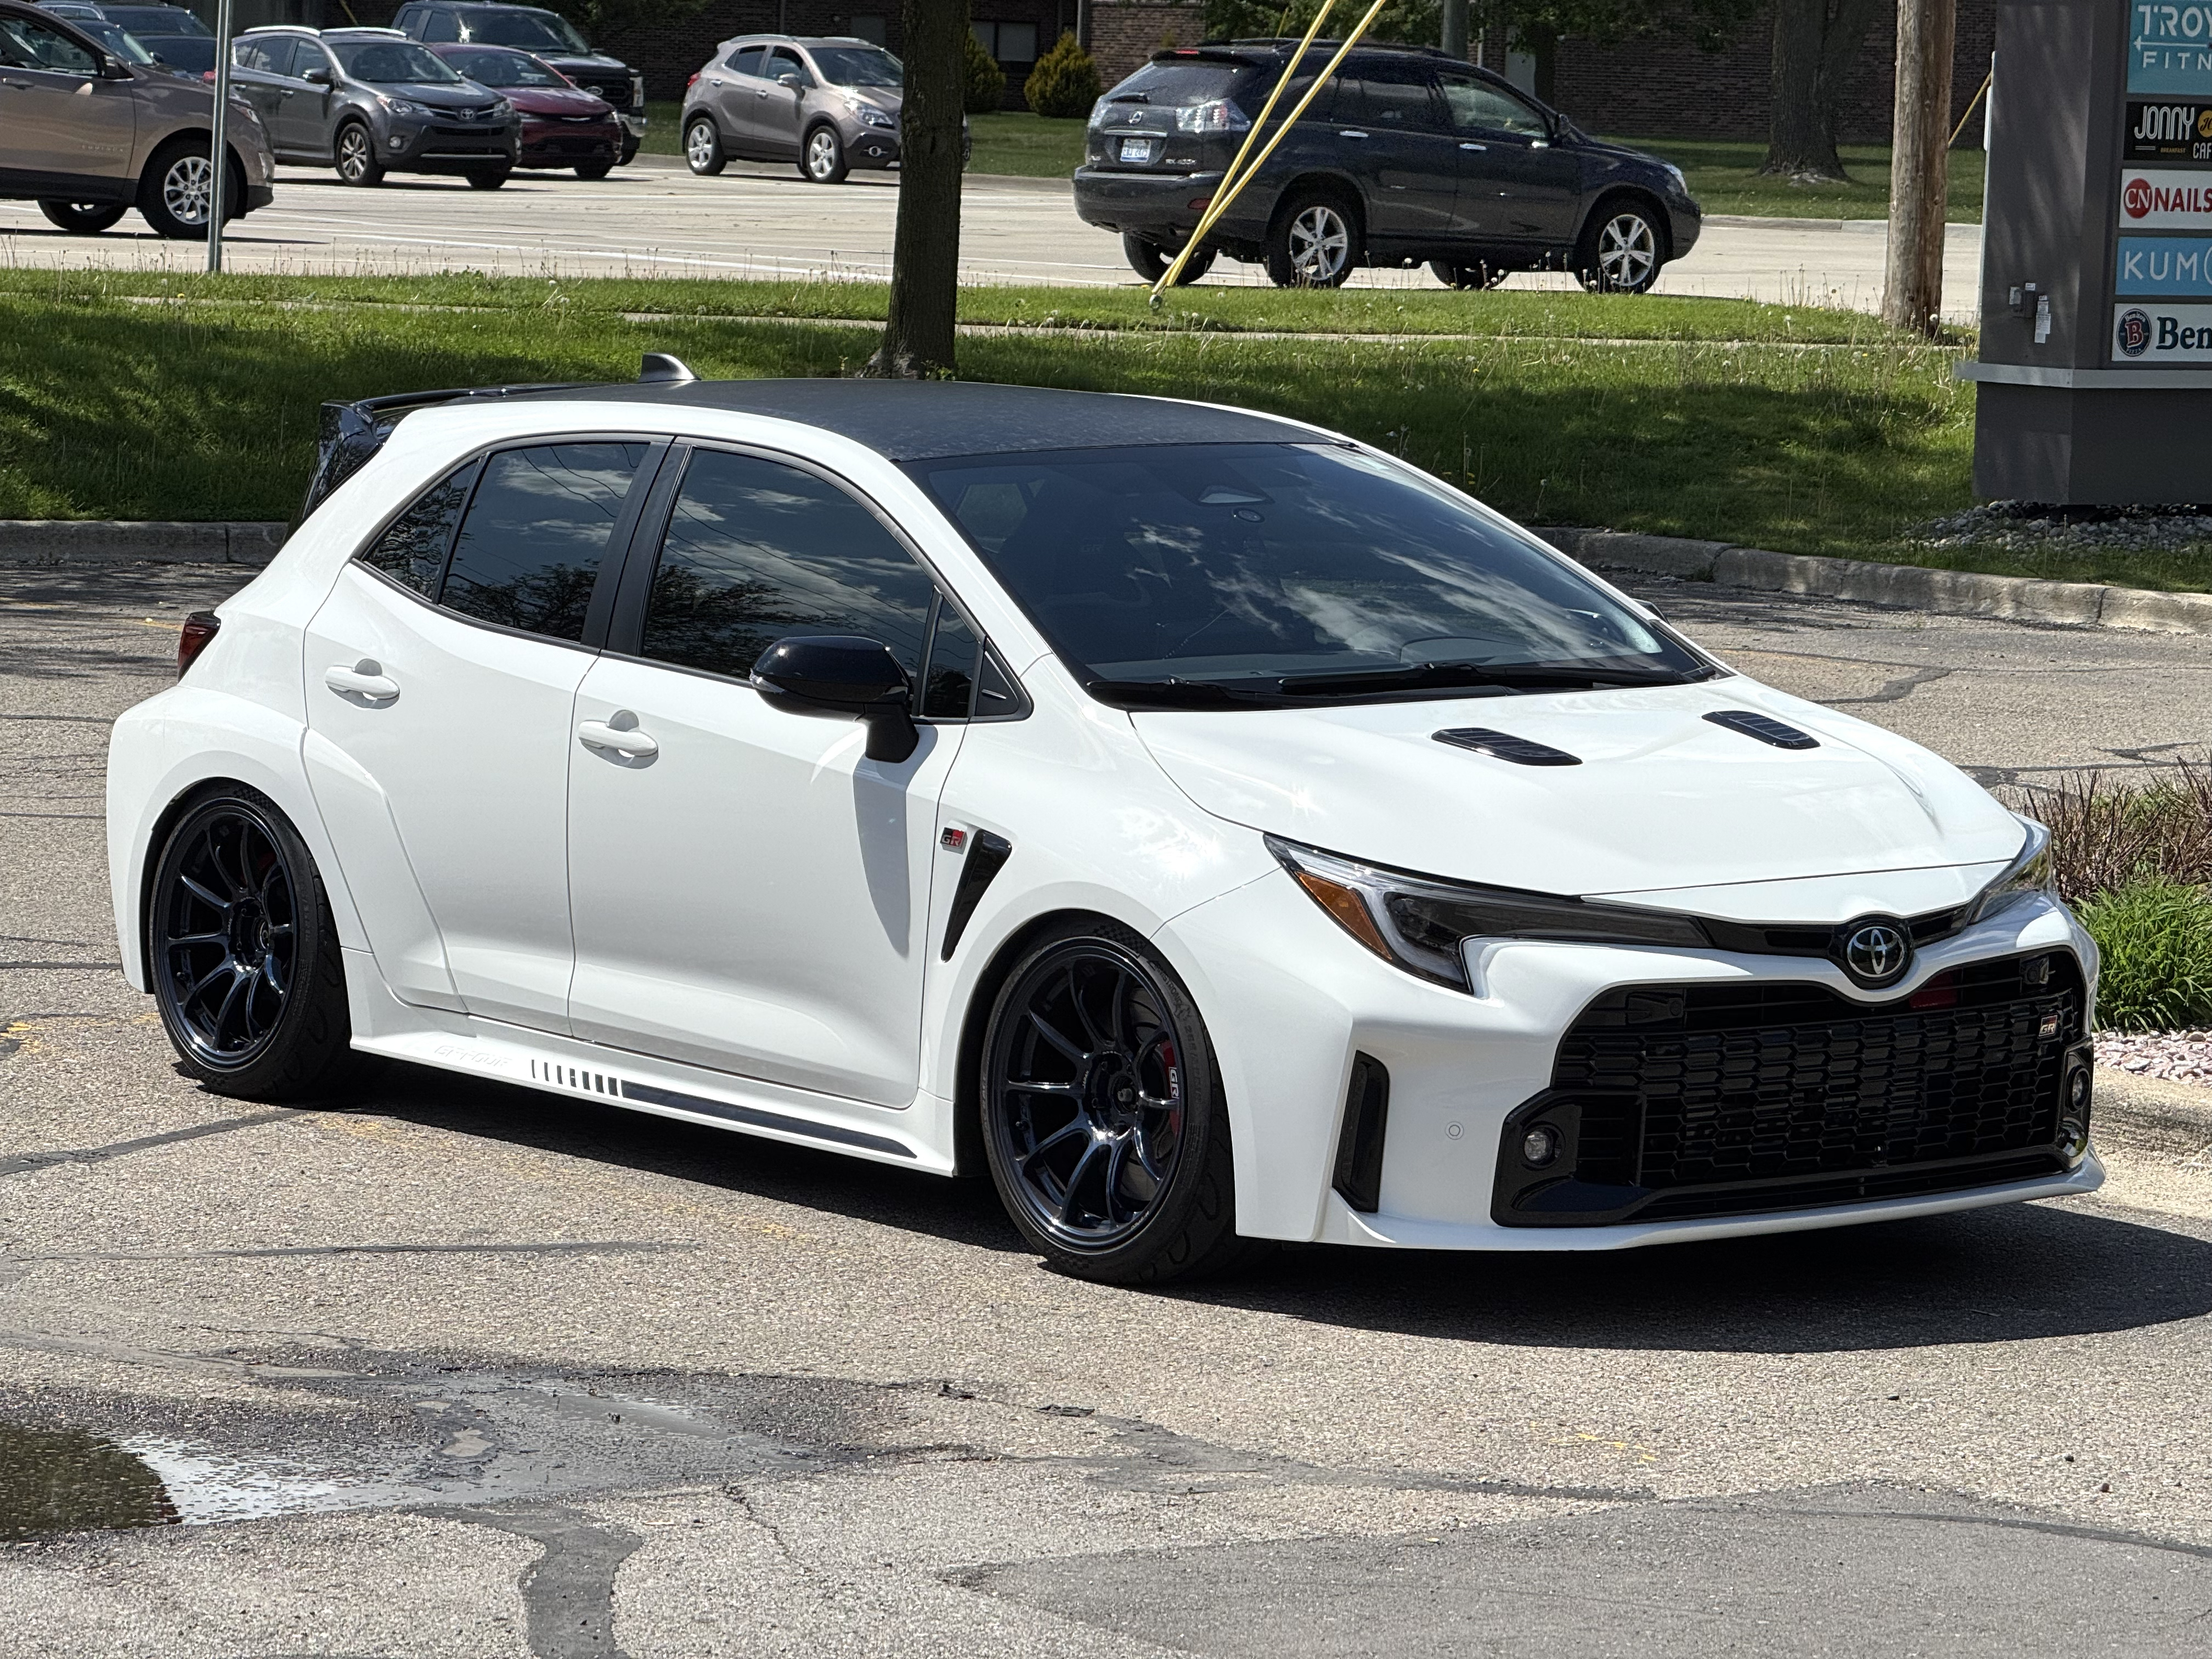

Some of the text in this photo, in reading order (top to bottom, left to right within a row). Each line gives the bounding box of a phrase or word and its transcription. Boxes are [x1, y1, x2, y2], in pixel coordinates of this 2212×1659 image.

[2134, 105, 2194, 140] JONNY
[2125, 187, 2212, 212] CN NAILS
[2124, 249, 2212, 283] KUM
[2155, 316, 2212, 349] Ben
[941, 834, 961, 847] GR
[2040, 1023, 2055, 1034] GR
[1170, 1069, 1179, 1097] GR
